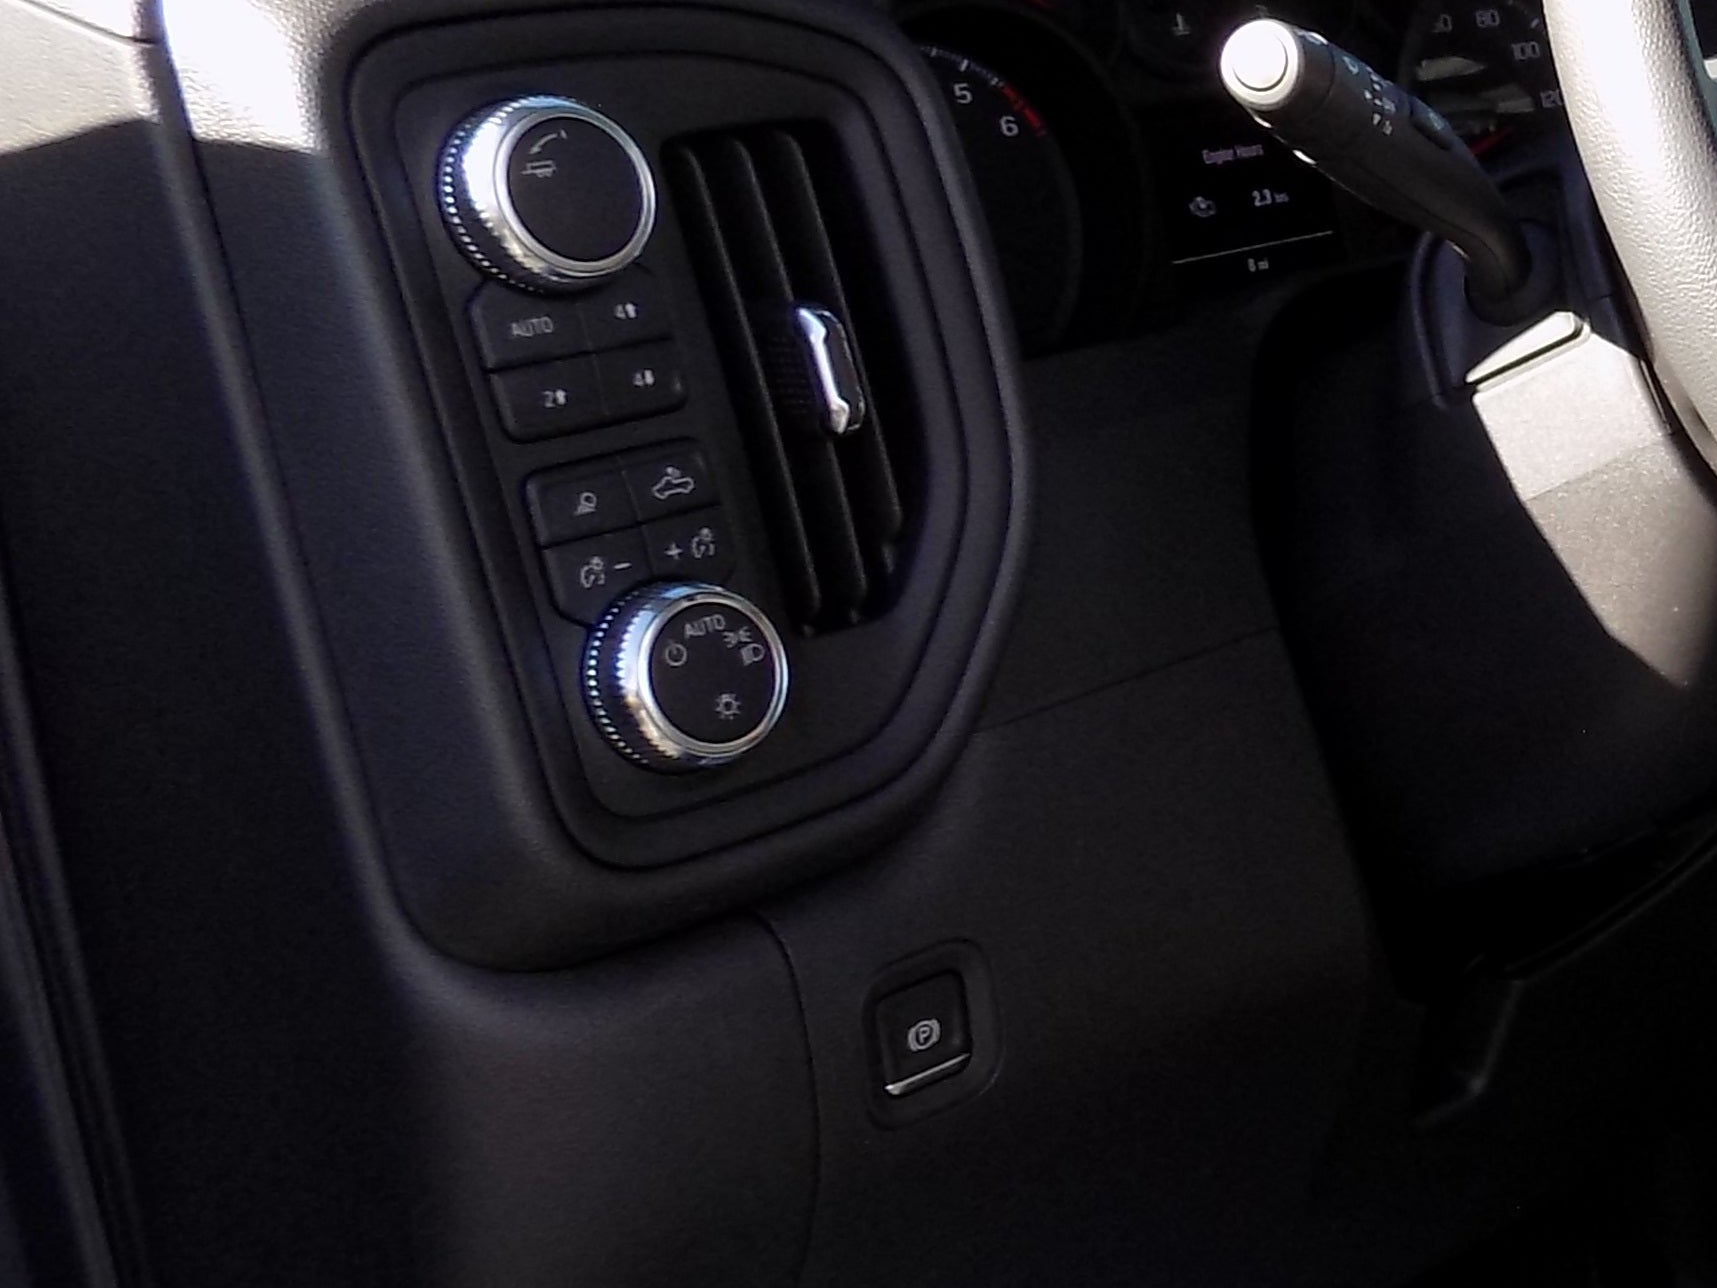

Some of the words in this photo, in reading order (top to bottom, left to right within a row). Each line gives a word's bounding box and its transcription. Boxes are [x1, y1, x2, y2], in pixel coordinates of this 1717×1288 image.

[953, 83, 973, 104] 5
[1000, 115, 1019, 136] 6
[511, 316, 554, 338] AUTO
[684, 614, 726, 639] AUTO
